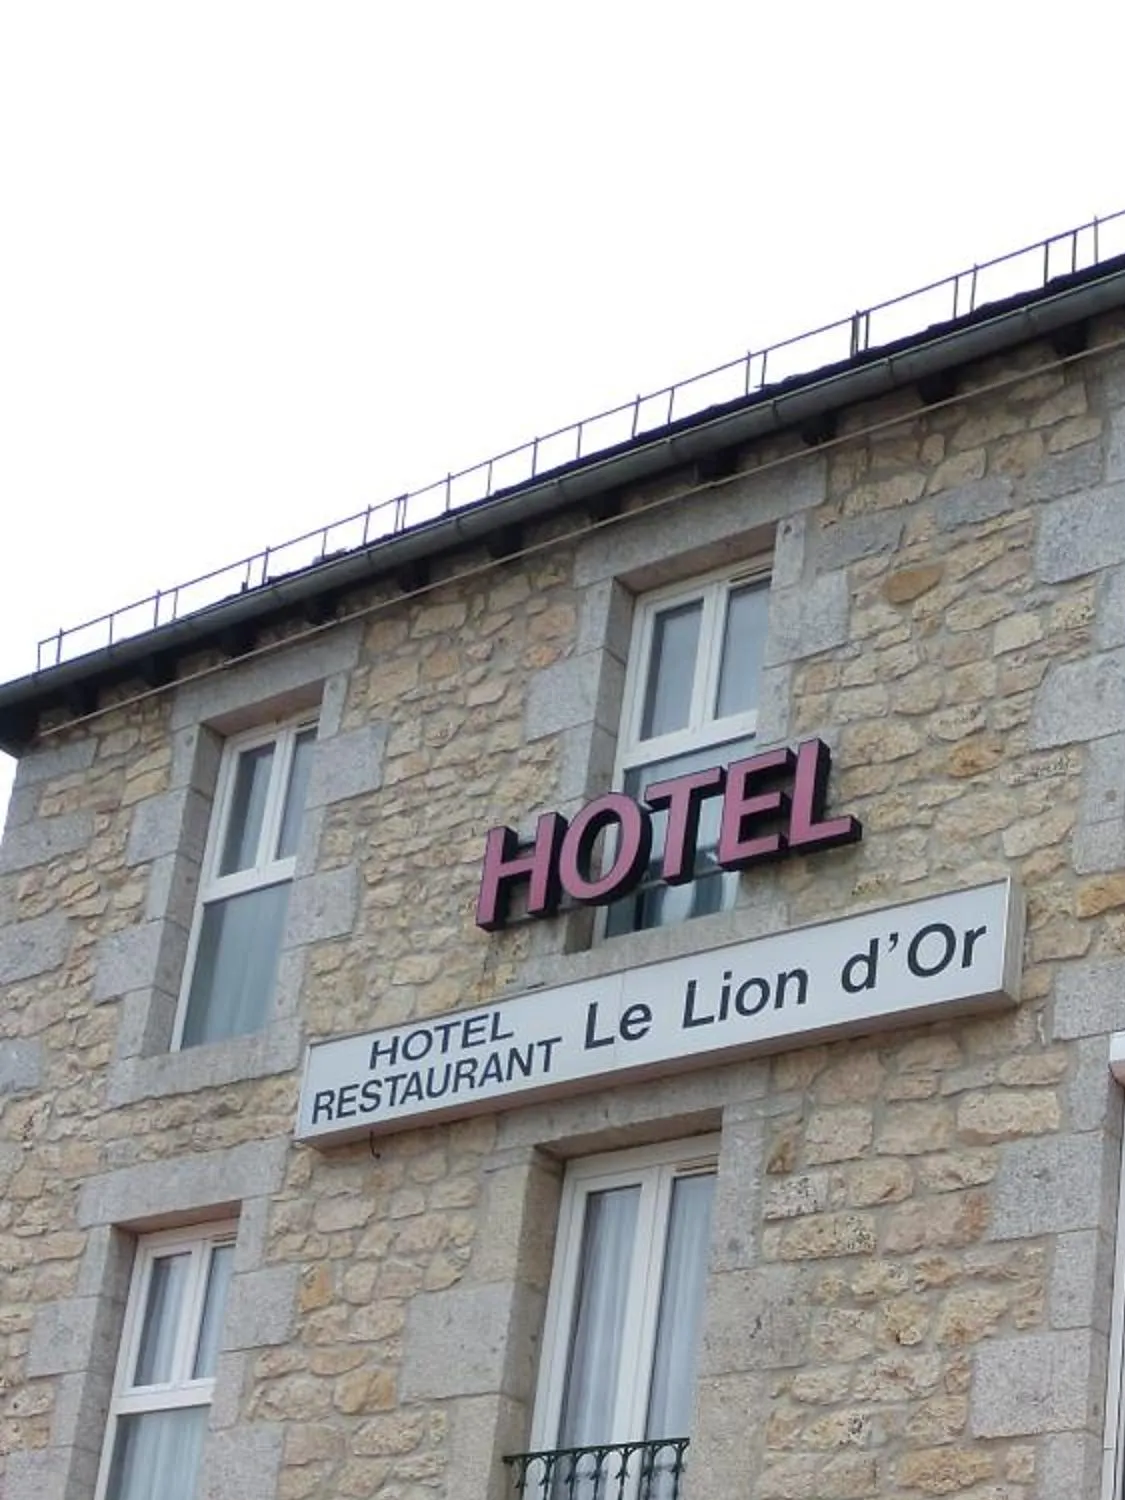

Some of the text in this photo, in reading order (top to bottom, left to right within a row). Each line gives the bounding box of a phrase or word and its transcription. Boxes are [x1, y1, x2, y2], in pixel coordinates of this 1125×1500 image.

[475, 738, 859, 930] HOTEL
[584, 921, 988, 1050] Le Lion d'Or
[311, 1037, 562, 1125] RESTAURANT
[368, 1011, 515, 1069] HOTEL
